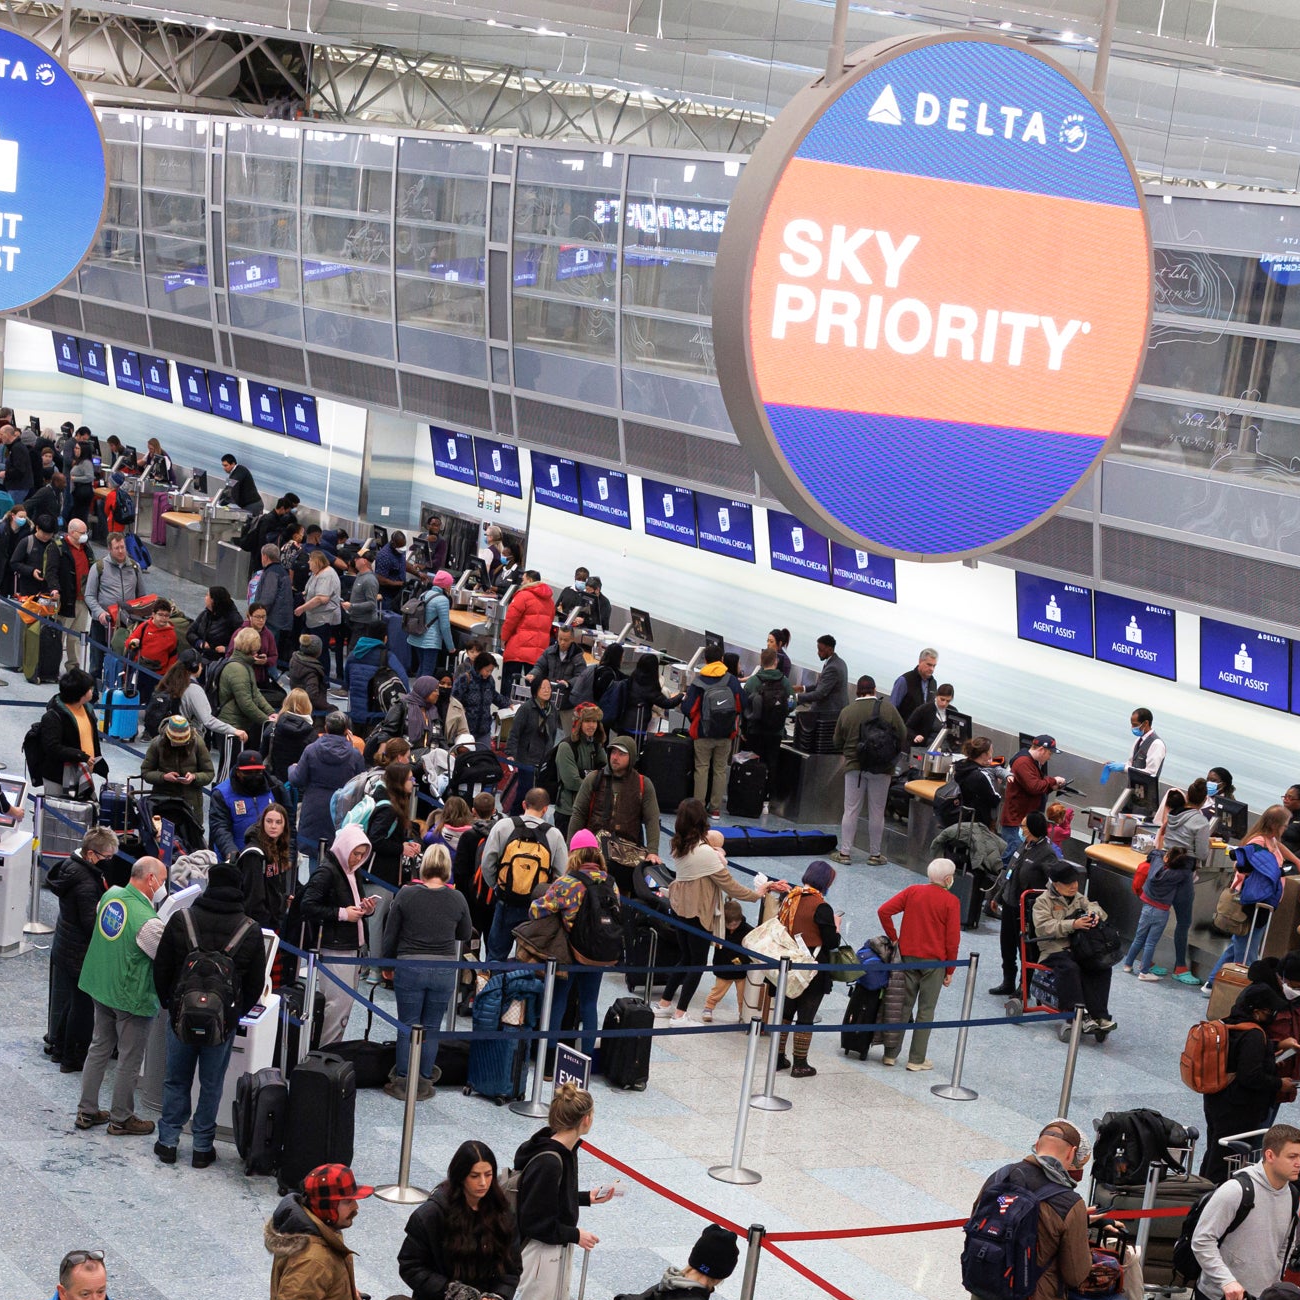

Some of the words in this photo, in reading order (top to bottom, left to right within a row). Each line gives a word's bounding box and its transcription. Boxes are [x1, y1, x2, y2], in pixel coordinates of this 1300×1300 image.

[915, 92, 1047, 145] DELTA
[778, 219, 920, 288] SKY
[771, 284, 1083, 371] PRIORITY
[535, 486, 562, 500] INTERNATIONAL
[583, 499, 610, 514] INTERNATIONAL
[646, 516, 675, 531] INTERNATIONAL
[675, 525, 695, 536] CHECK-IN
[700, 531, 732, 546] INTERNATIONAL
[732, 539, 753, 551] CHECK-IN
[772, 551, 806, 567] INTERNATIONAL
[806, 560, 827, 573] CHECK-IN
[833, 567, 870, 584] INTERNATIONAL
[870, 577, 893, 590] CHECK-IN
[1068, 585, 1084, 594] DELTA
[1150, 606, 1167, 615] DELTA
[1033, 620, 1054, 634] AGENT
[1054, 626, 1076, 640] ASSIST
[1262, 634, 1280, 643] DELTA
[1111, 641, 1134, 656] AGENT
[1135, 647, 1157, 662] ASSIST
[1218, 670, 1243, 685] AGENT
[1244, 677, 1269, 692] ASSIST
[559, 1069, 583, 1088] EXIT
